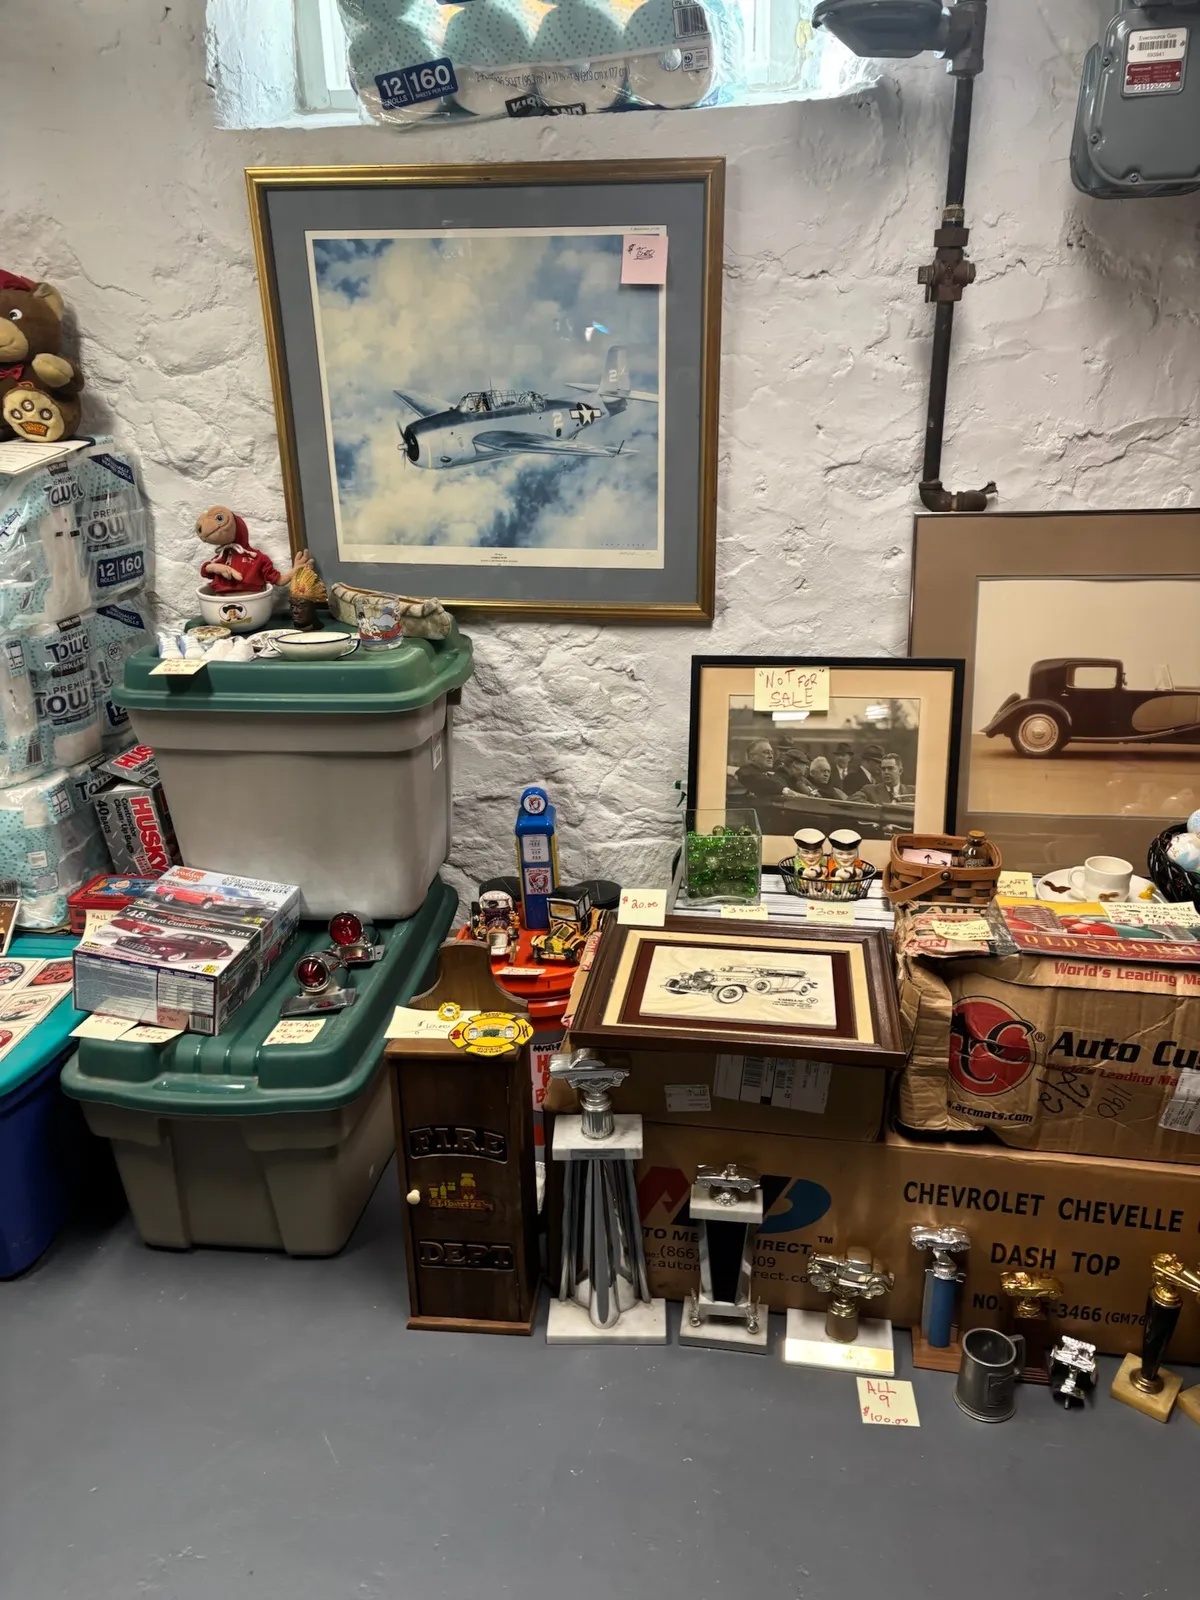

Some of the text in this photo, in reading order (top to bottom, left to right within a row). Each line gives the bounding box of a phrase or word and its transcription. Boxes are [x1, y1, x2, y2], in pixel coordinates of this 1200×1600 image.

[382, 65, 451, 97] 12 160
[99, 555, 142, 578] 12 160
[770, 687, 813, 704] SALE
[97, 800, 112, 834] 40 BAGS
[121, 798, 137, 838] Contractor
[130, 796, 170, 873] HUSKY
[147, 915, 167, 924] Ford
[168, 918, 198, 930] Custom
[200, 924, 225, 934] Coupe
[1054, 962, 1200, 986] World's Leading Ma
[1048, 1032, 1141, 1062] Auto
[410, 1127, 505, 1154] FIRE
[903, 1181, 1185, 1233] CHEVROLET CHEVELLE
[419, 1241, 513, 1264] DEPT
[990, 1242, 1121, 1277] DASH TOP
[972, 1293, 1003, 1311] NO.
[867, 1380, 897, 1395] ALL
[879, 1394, 890, 1407] 9
